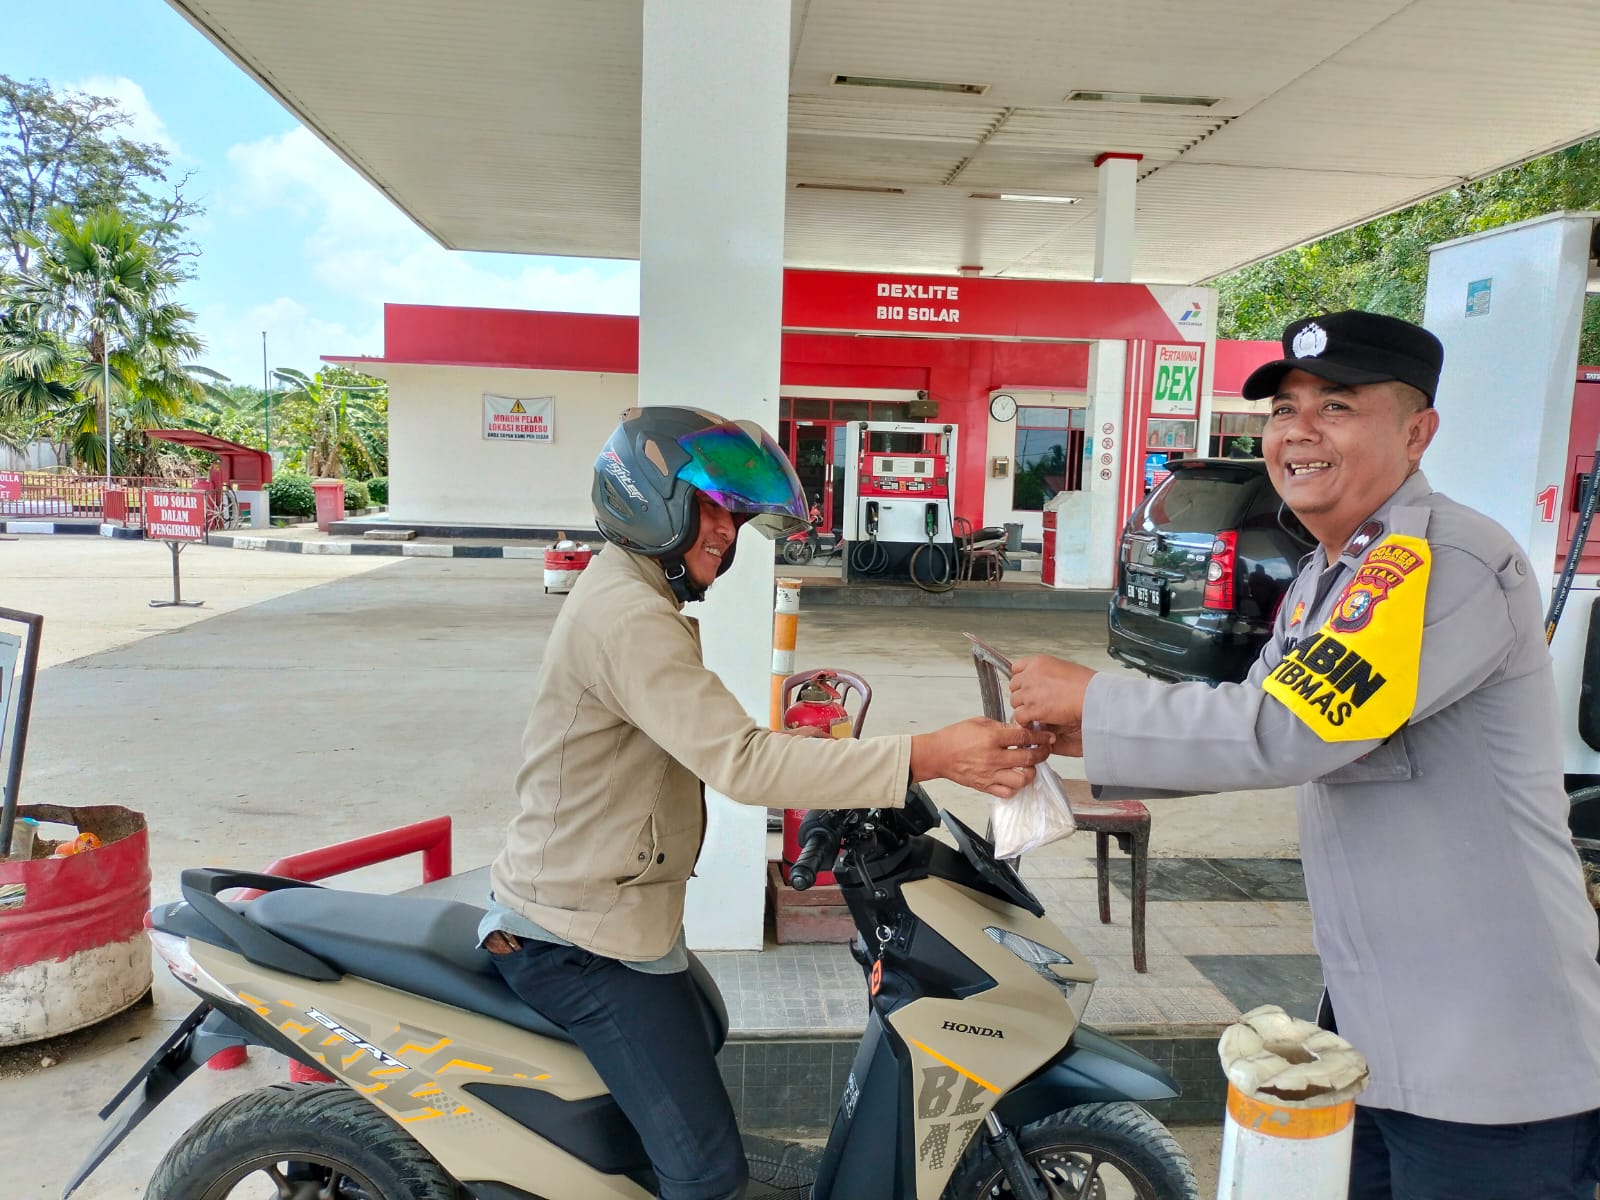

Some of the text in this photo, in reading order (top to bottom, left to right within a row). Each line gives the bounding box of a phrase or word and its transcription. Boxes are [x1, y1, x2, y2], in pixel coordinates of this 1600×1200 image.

[877, 283, 959, 300] DEXLITE
[877, 306, 960, 323] BIO SOLAR
[1155, 365, 1197, 402] DEX
[493, 414, 543, 424] MOHON PELAN
[488, 423, 548, 433] LOKASI BERDEBU
[153, 494, 198, 509] BIO SOLAR
[1536, 485, 1559, 522] 1
[161, 509, 189, 522] DALAM
[150, 522, 201, 538] PENGIRIMAN
[1362, 568, 1398, 583] RIAU
[941, 1020, 1005, 1039] HONDA
